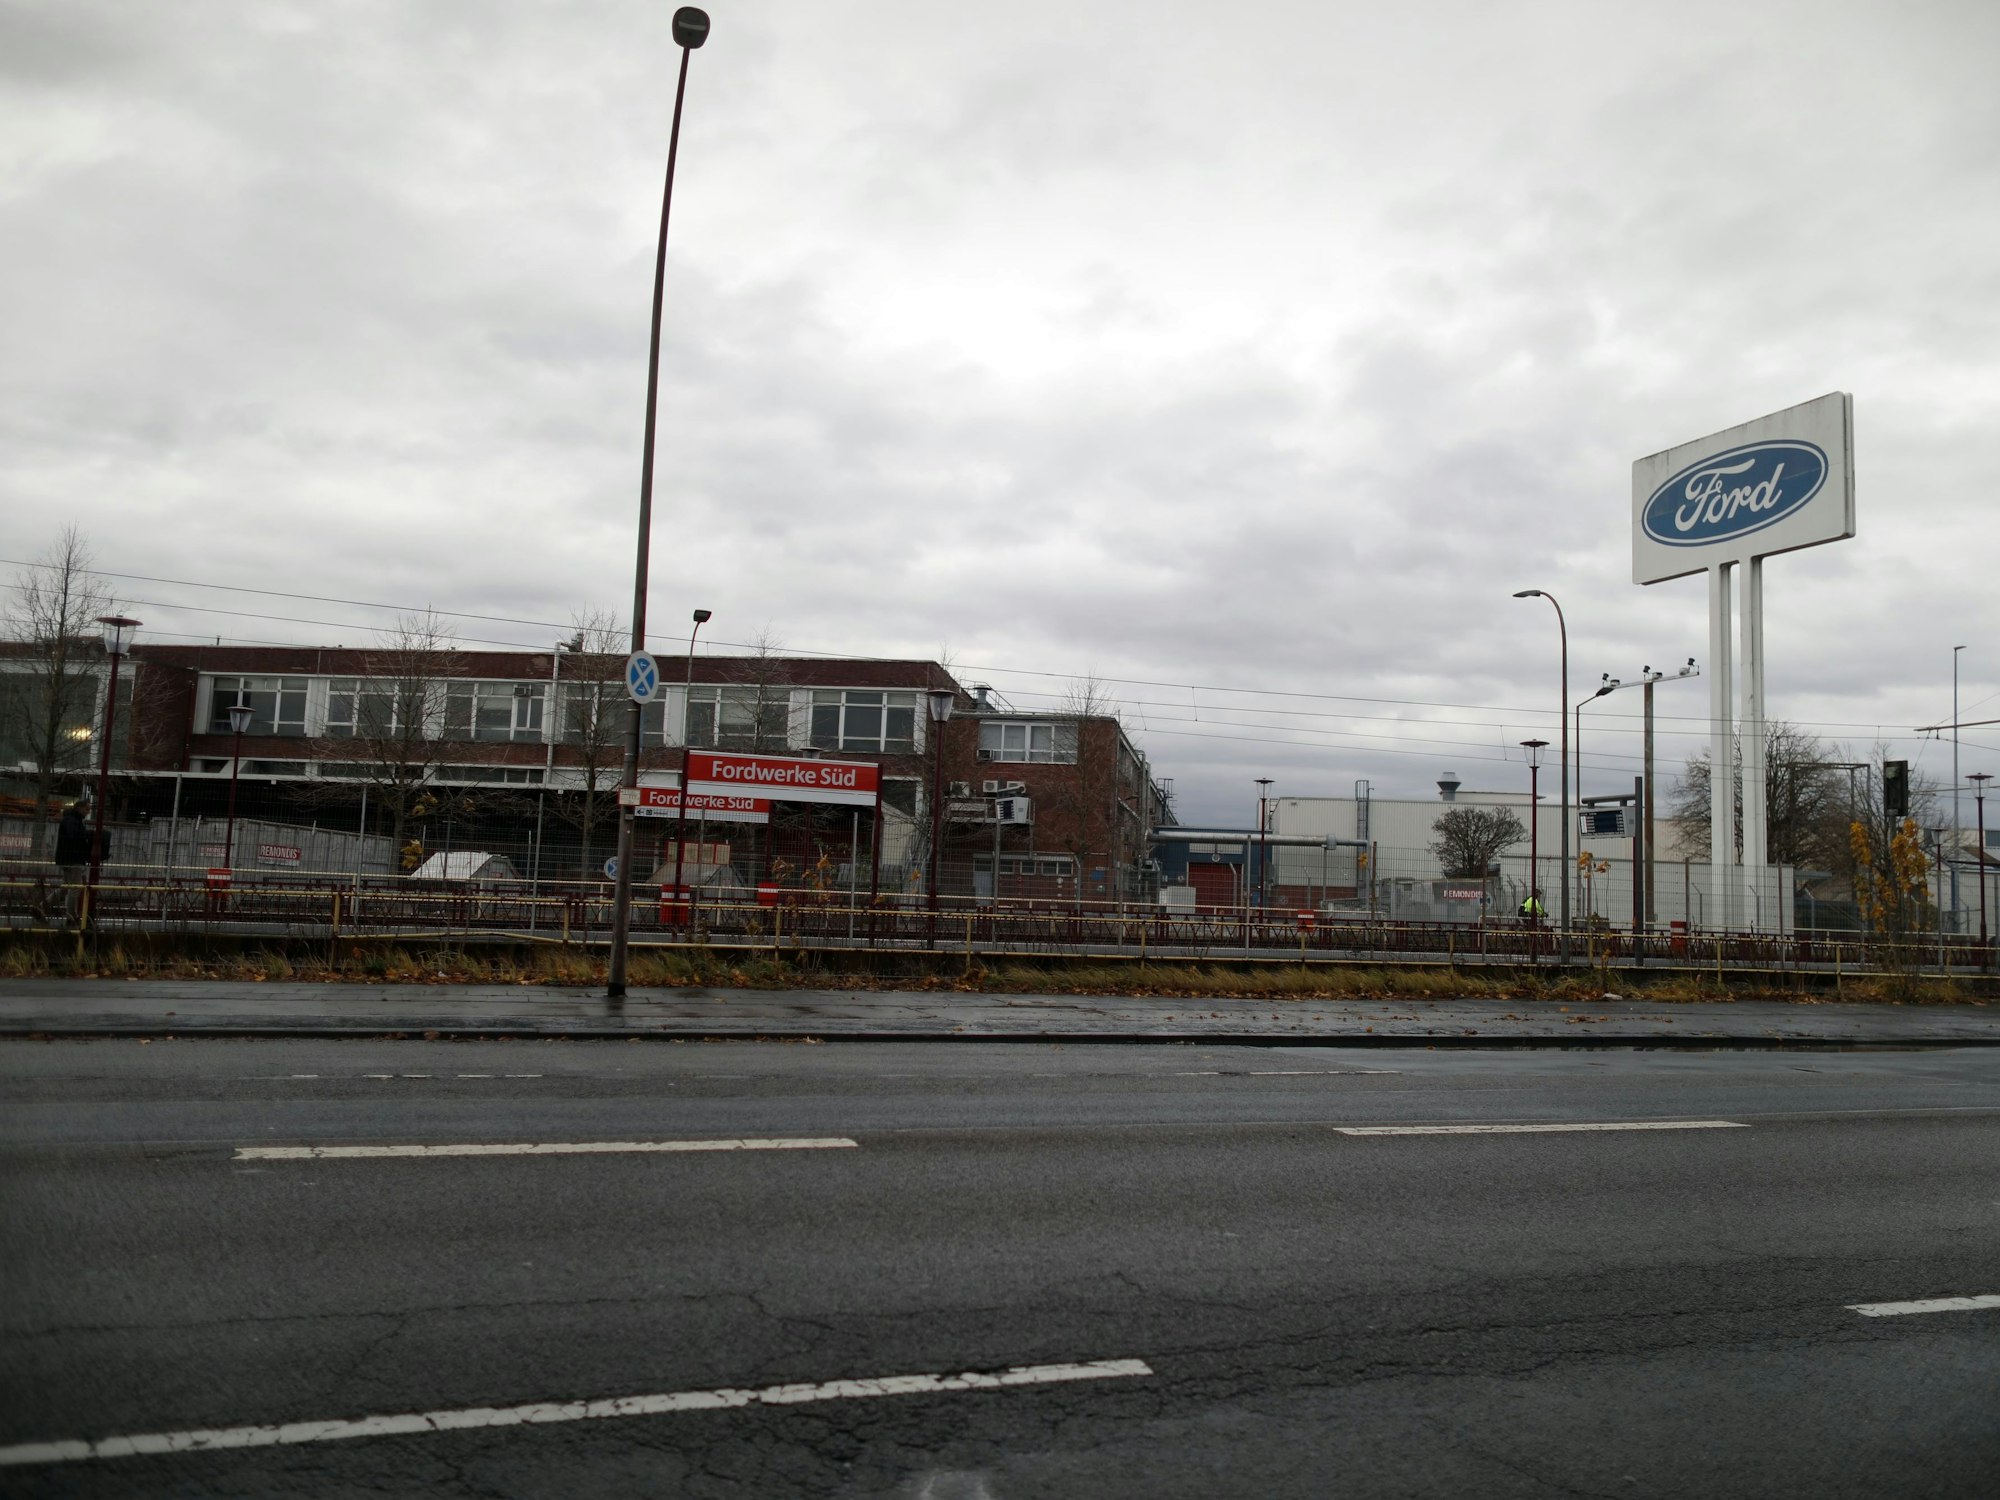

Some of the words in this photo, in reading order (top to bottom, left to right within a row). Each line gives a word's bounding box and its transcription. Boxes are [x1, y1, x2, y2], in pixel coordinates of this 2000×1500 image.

[1674, 458, 1785, 532] Ford
[711, 760, 817, 785] Fordwerke
[819, 767, 856, 787] Süd
[649, 791, 725, 808] Fordwerke
[727, 797, 754, 810] Süd
[260, 845, 298, 859] REMONDIS
